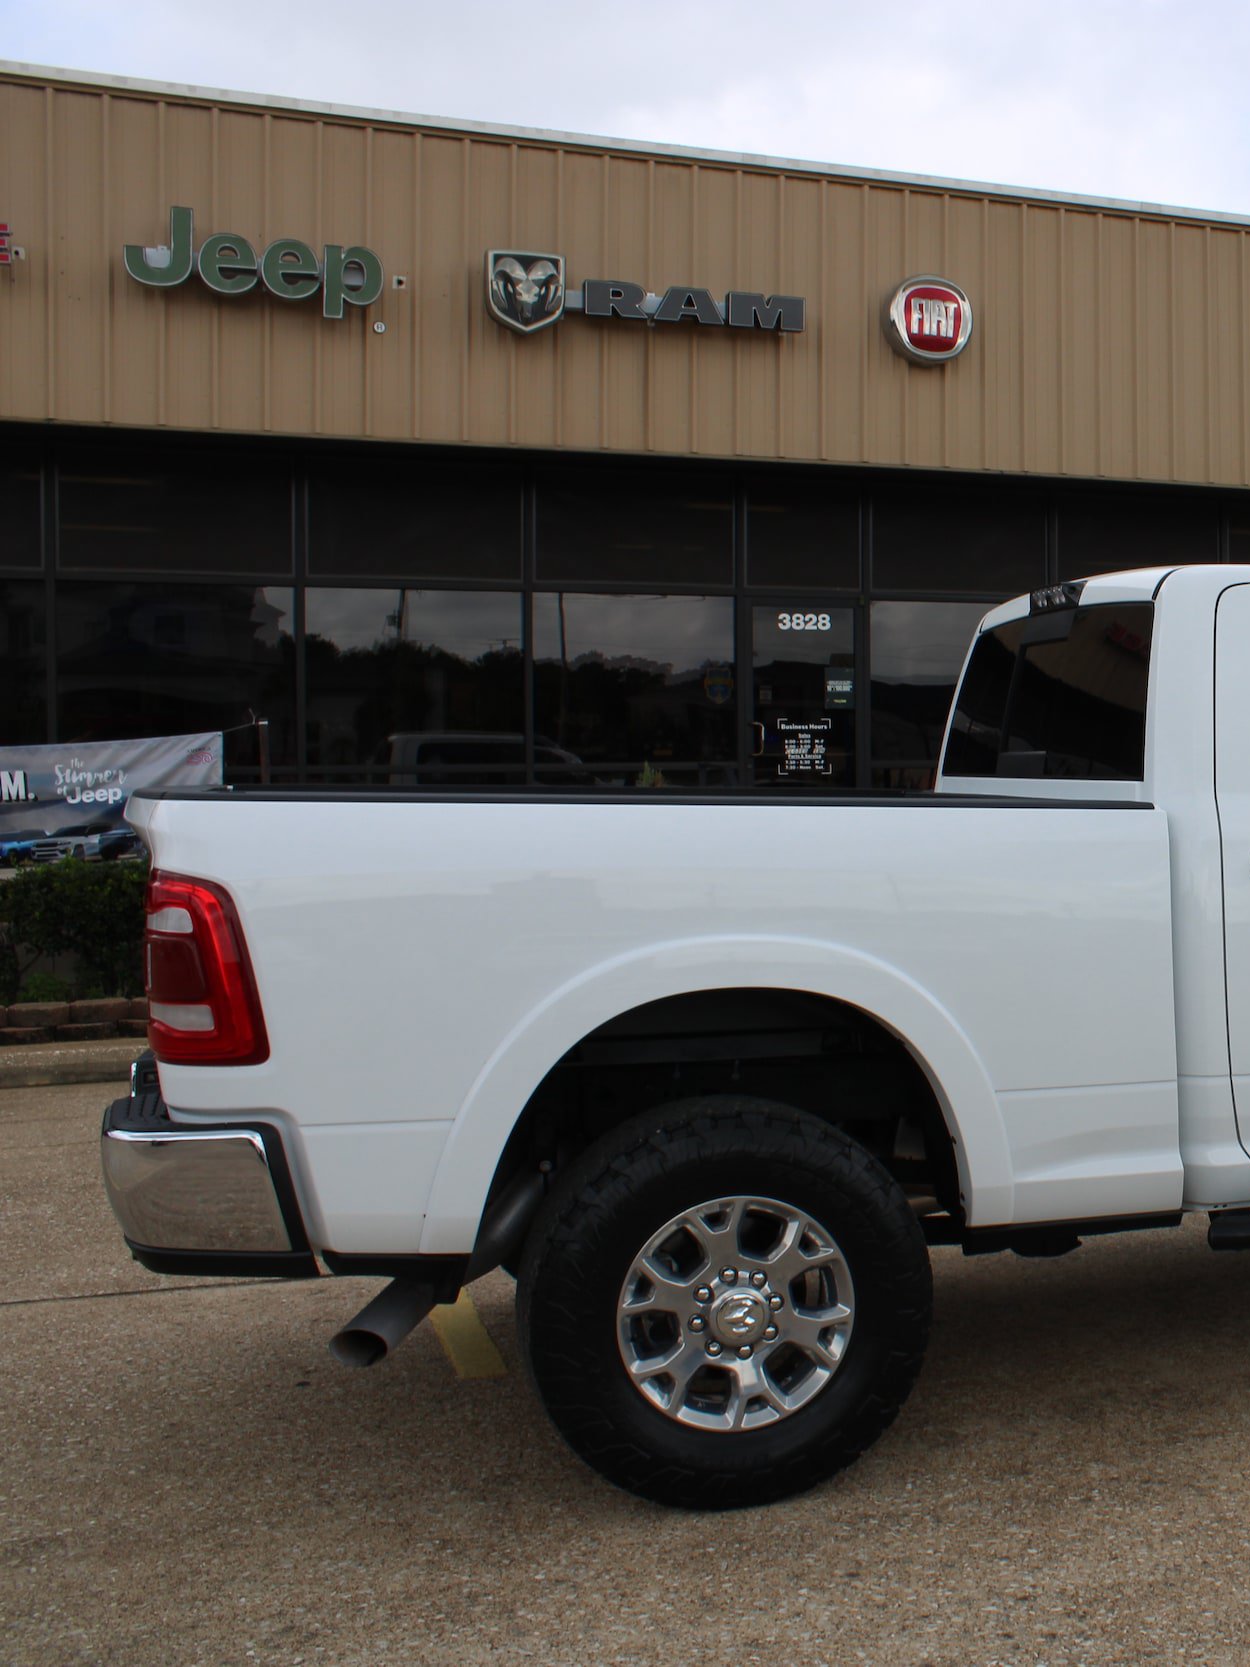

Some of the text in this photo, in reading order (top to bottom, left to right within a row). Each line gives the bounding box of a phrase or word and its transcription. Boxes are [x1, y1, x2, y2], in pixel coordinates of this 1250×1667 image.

[123, 205, 385, 320] Jeep
[581, 278, 806, 333] RAM
[910, 296, 959, 339] FIAT
[777, 612, 831, 630] 3828
[70, 757, 85, 769] the
[66, 786, 123, 805] Jeep
